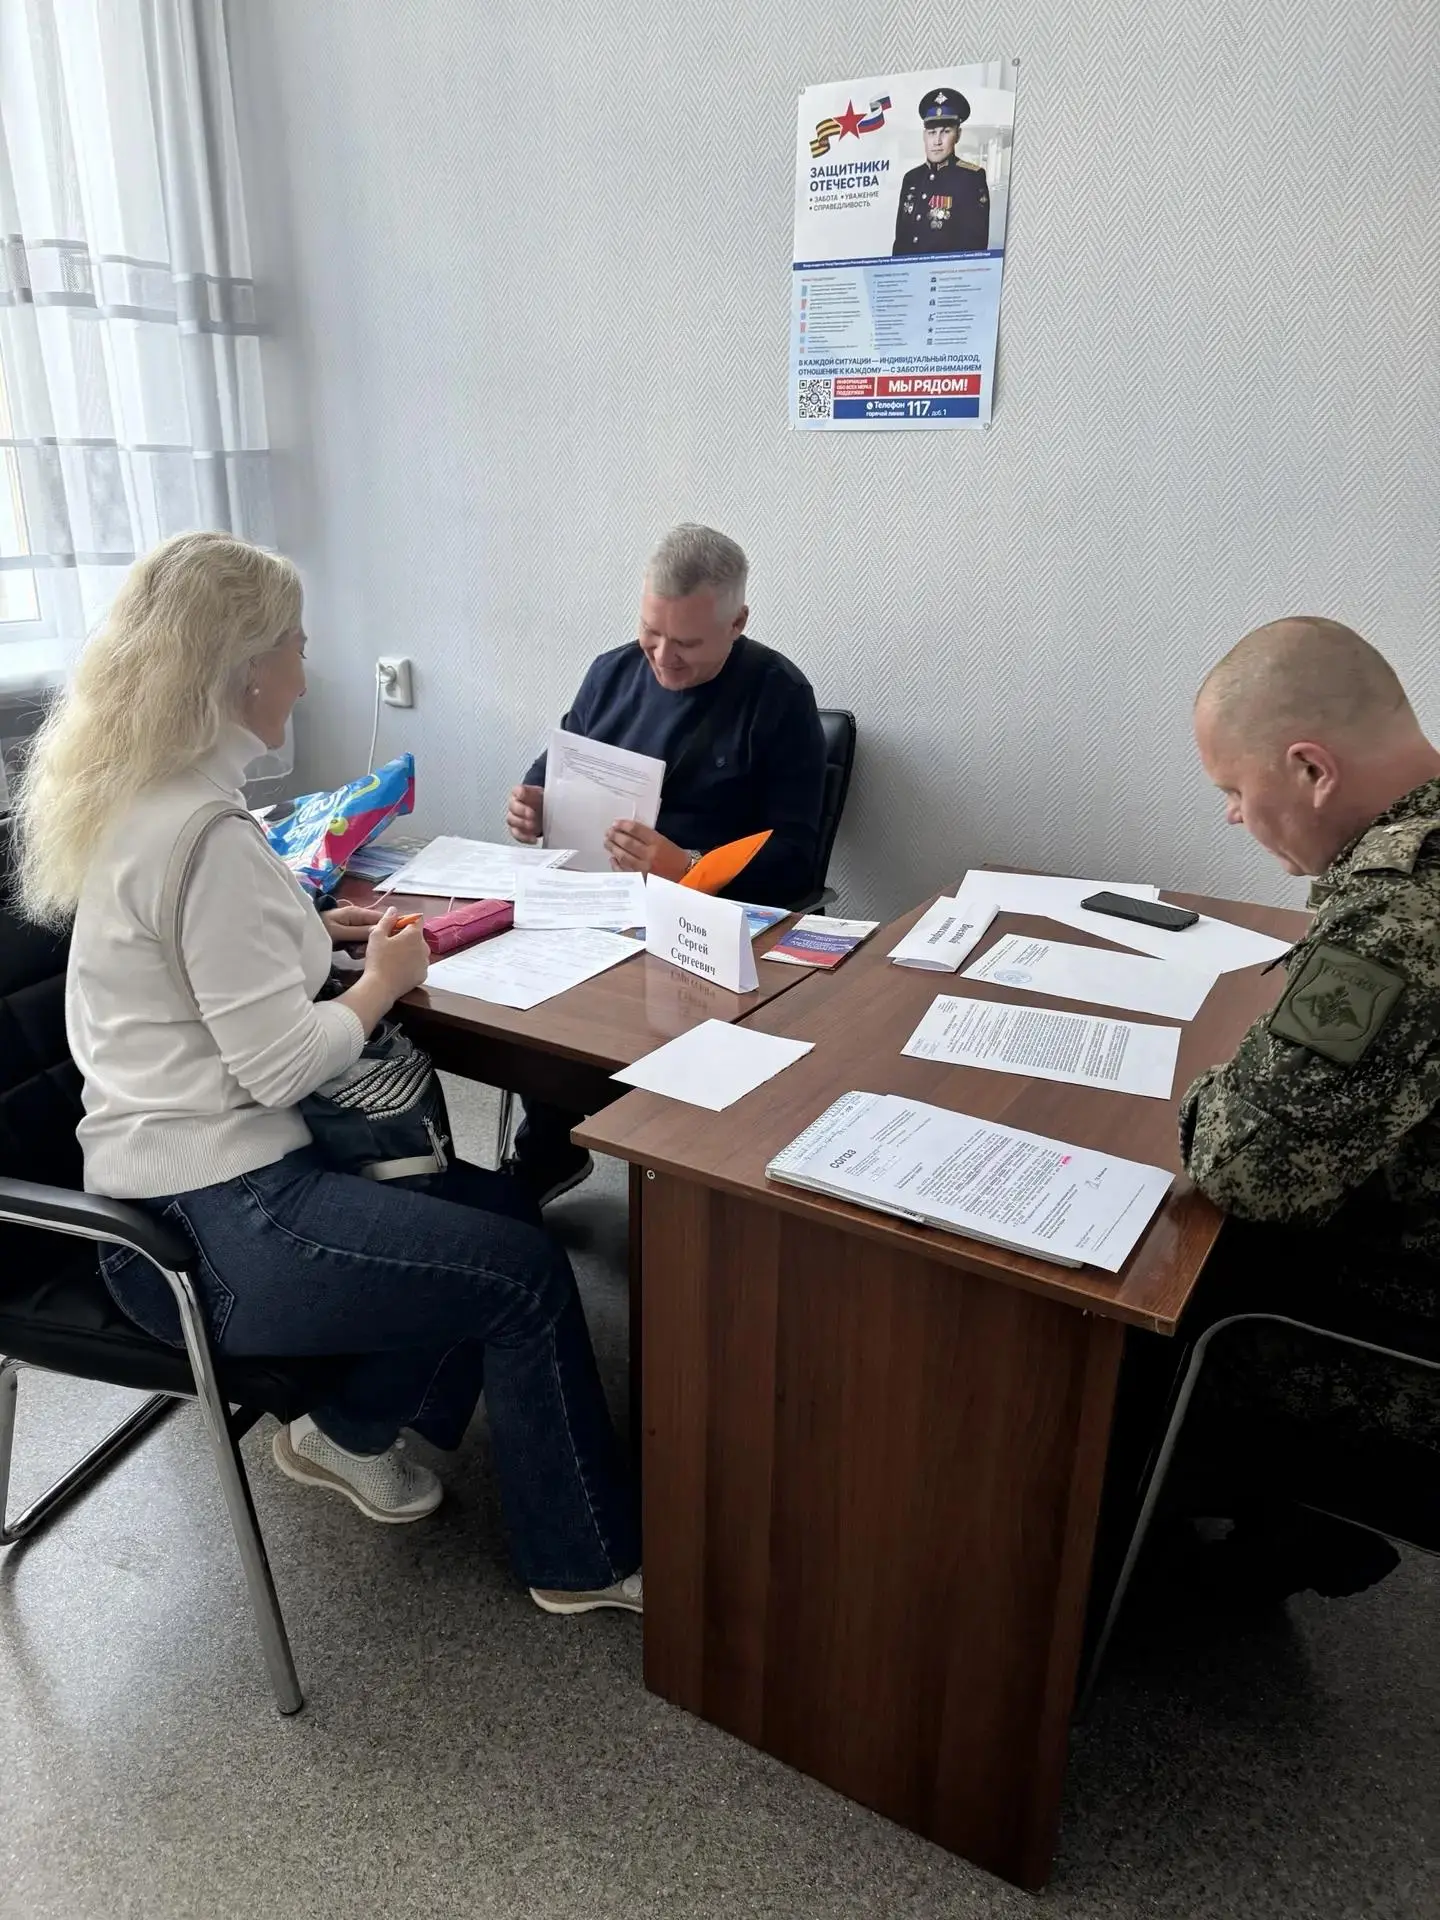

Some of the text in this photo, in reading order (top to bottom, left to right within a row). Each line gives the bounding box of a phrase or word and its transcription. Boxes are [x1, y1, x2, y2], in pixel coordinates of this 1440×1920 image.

[810, 160, 889, 178] ЗАЩИТНИКИ
[810, 175, 879, 191] ОТЕЧЕСТВА
[814, 191, 879, 203] ЗАБОТА УВАЖЕНИЕ
[813, 200, 871, 211] СПРАВЕДЛИВОСТЬ
[804, 358, 834, 366] КАЖДОЙ
[835, 357, 871, 365] СИТУАЦИИ
[880, 353, 946, 363] ИНДИВИДУАЛЬНЫЙ
[845, 366, 881, 375] КАЖДОМУ
[896, 364, 929, 372] ЗАБОТОЙ
[936, 364, 981, 372] ВНИМАНИЕМ
[888, 378, 968, 395] МЫ РЯДОМ!
[874, 401, 905, 410] Телефон
[679, 916, 707, 937] Орлов
[678, 933, 708, 956] Сергей
[671, 947, 716, 976] Сергеевич
